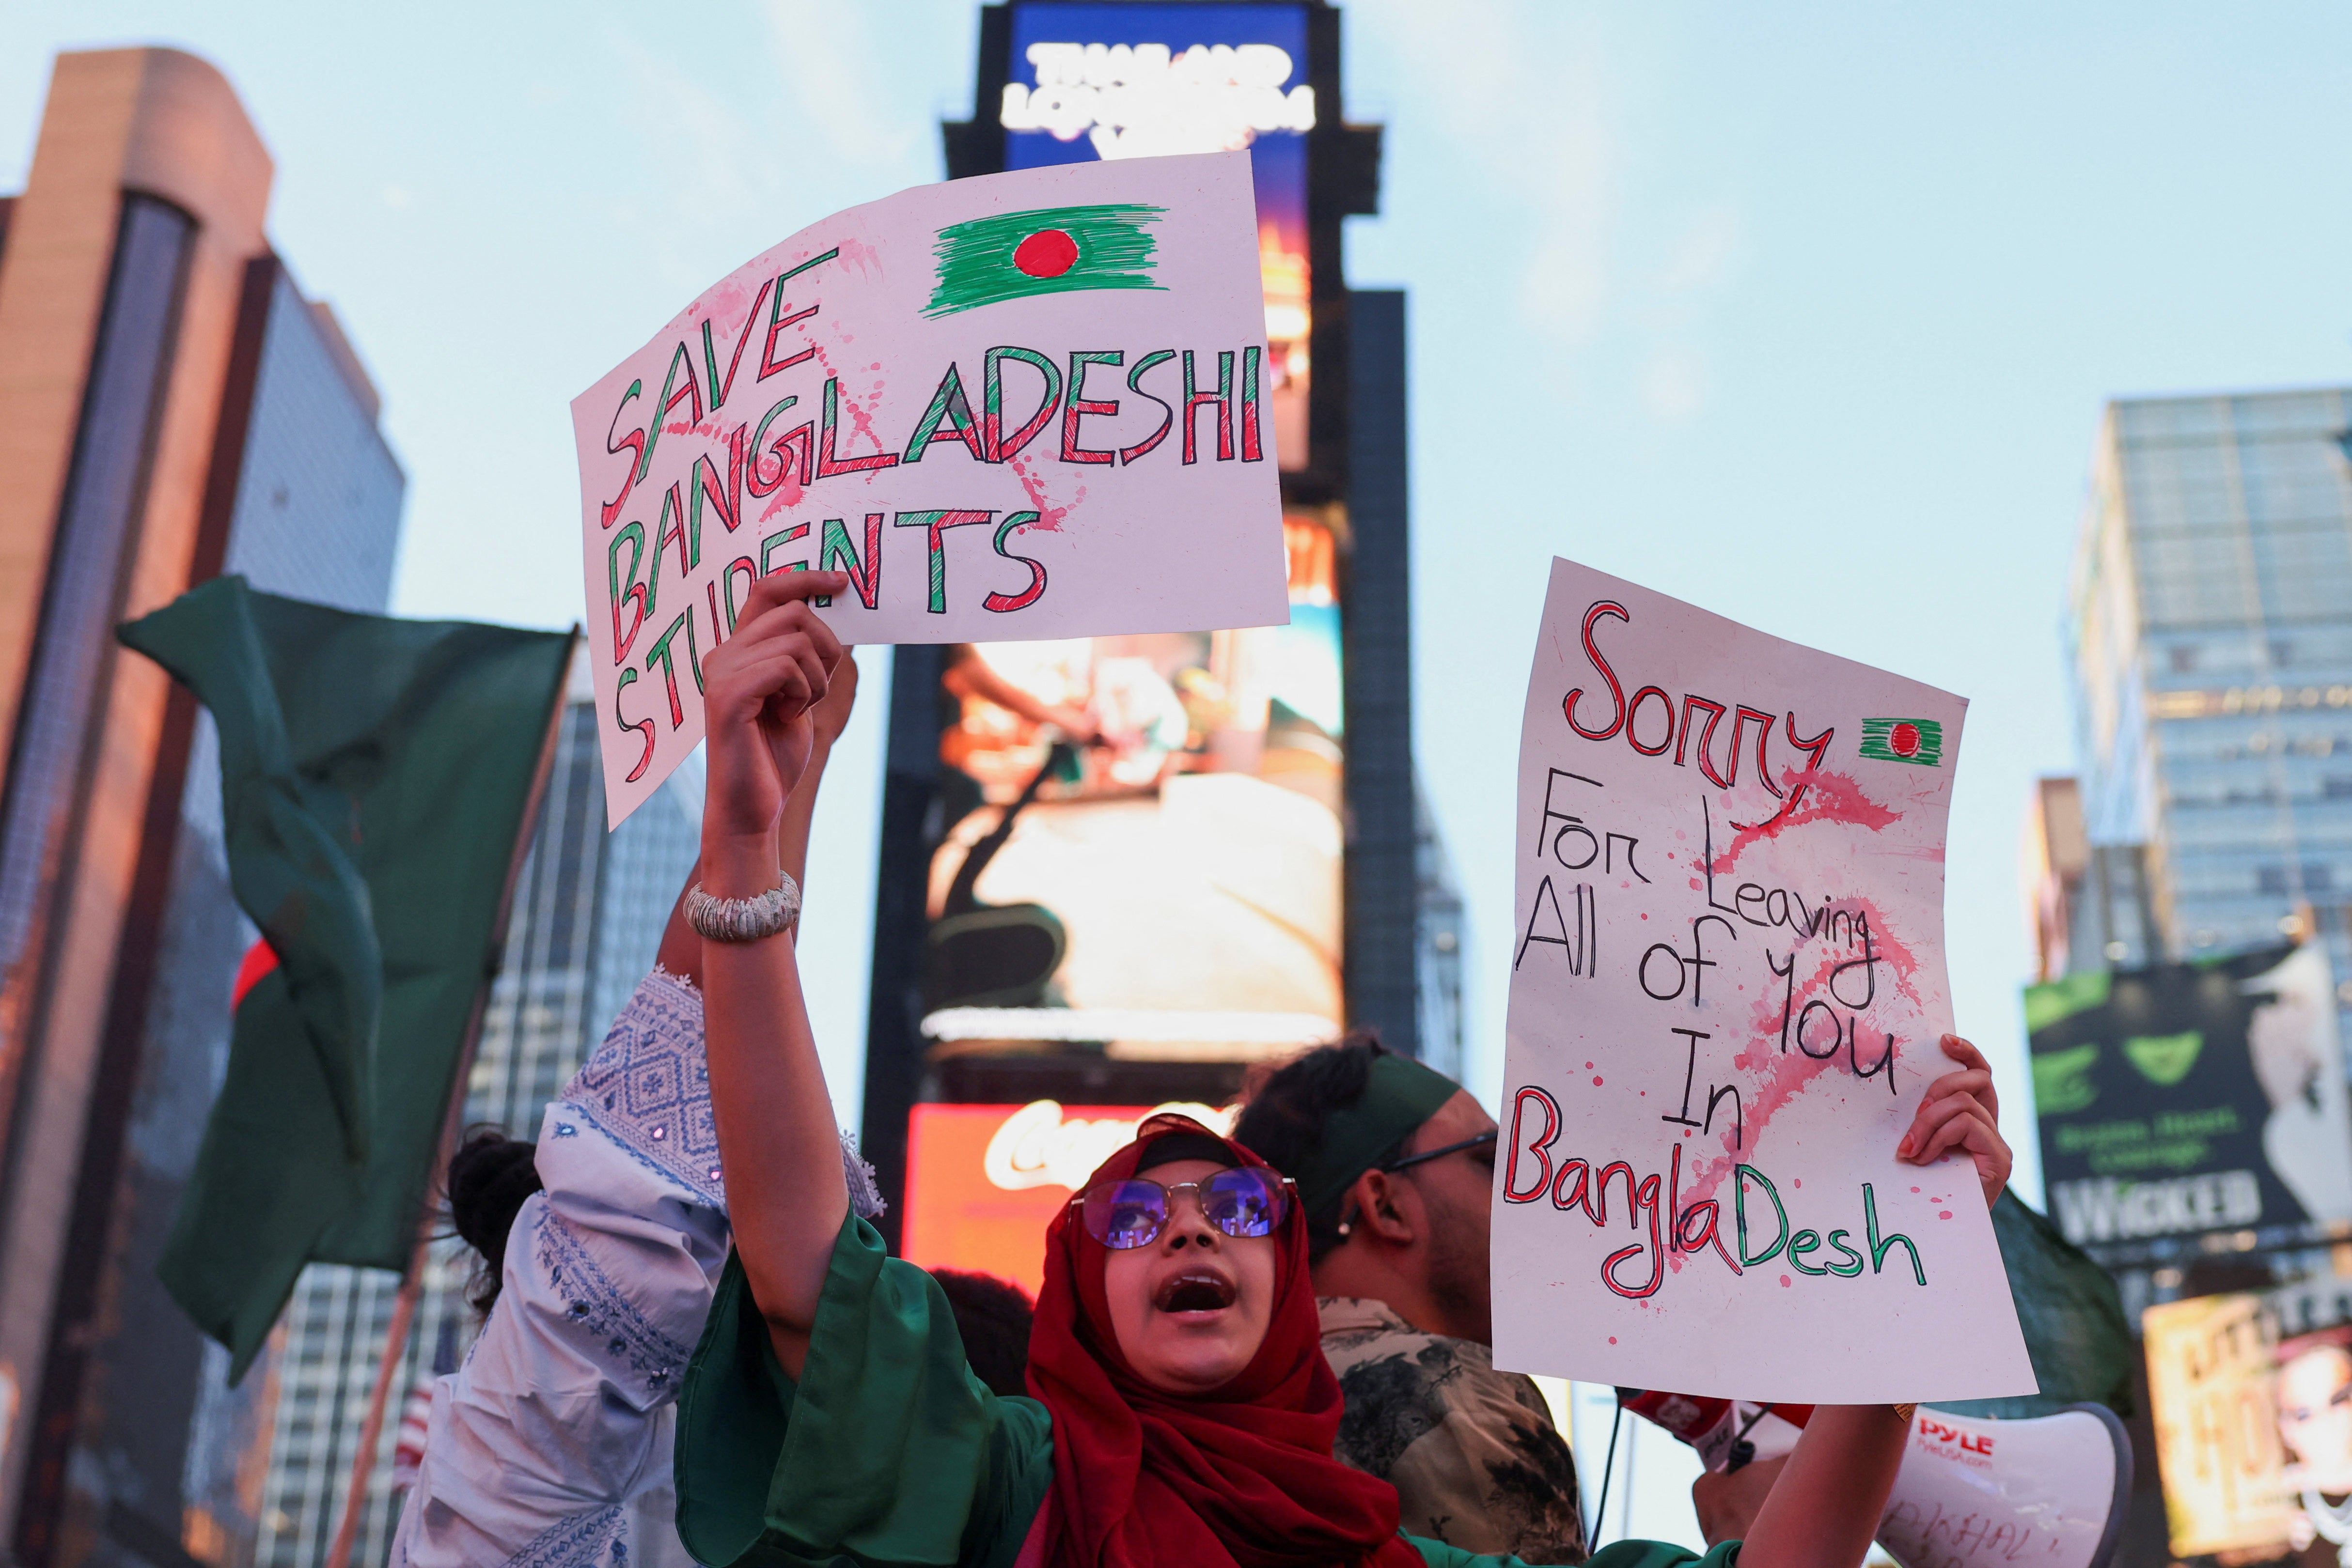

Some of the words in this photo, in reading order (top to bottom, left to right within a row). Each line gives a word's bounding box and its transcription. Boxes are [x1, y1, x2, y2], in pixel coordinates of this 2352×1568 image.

[601, 248, 840, 529] SAVE
[608, 345, 1263, 666] BANGLADESHI
[1562, 600, 1835, 831] Sorry
[1515, 875, 1595, 978] All
[1537, 767, 1652, 884] For
[1702, 795, 1882, 1009] Leaving
[1662, 1027, 1742, 1150] In
[1920, 1417, 1994, 1455] PYLE
